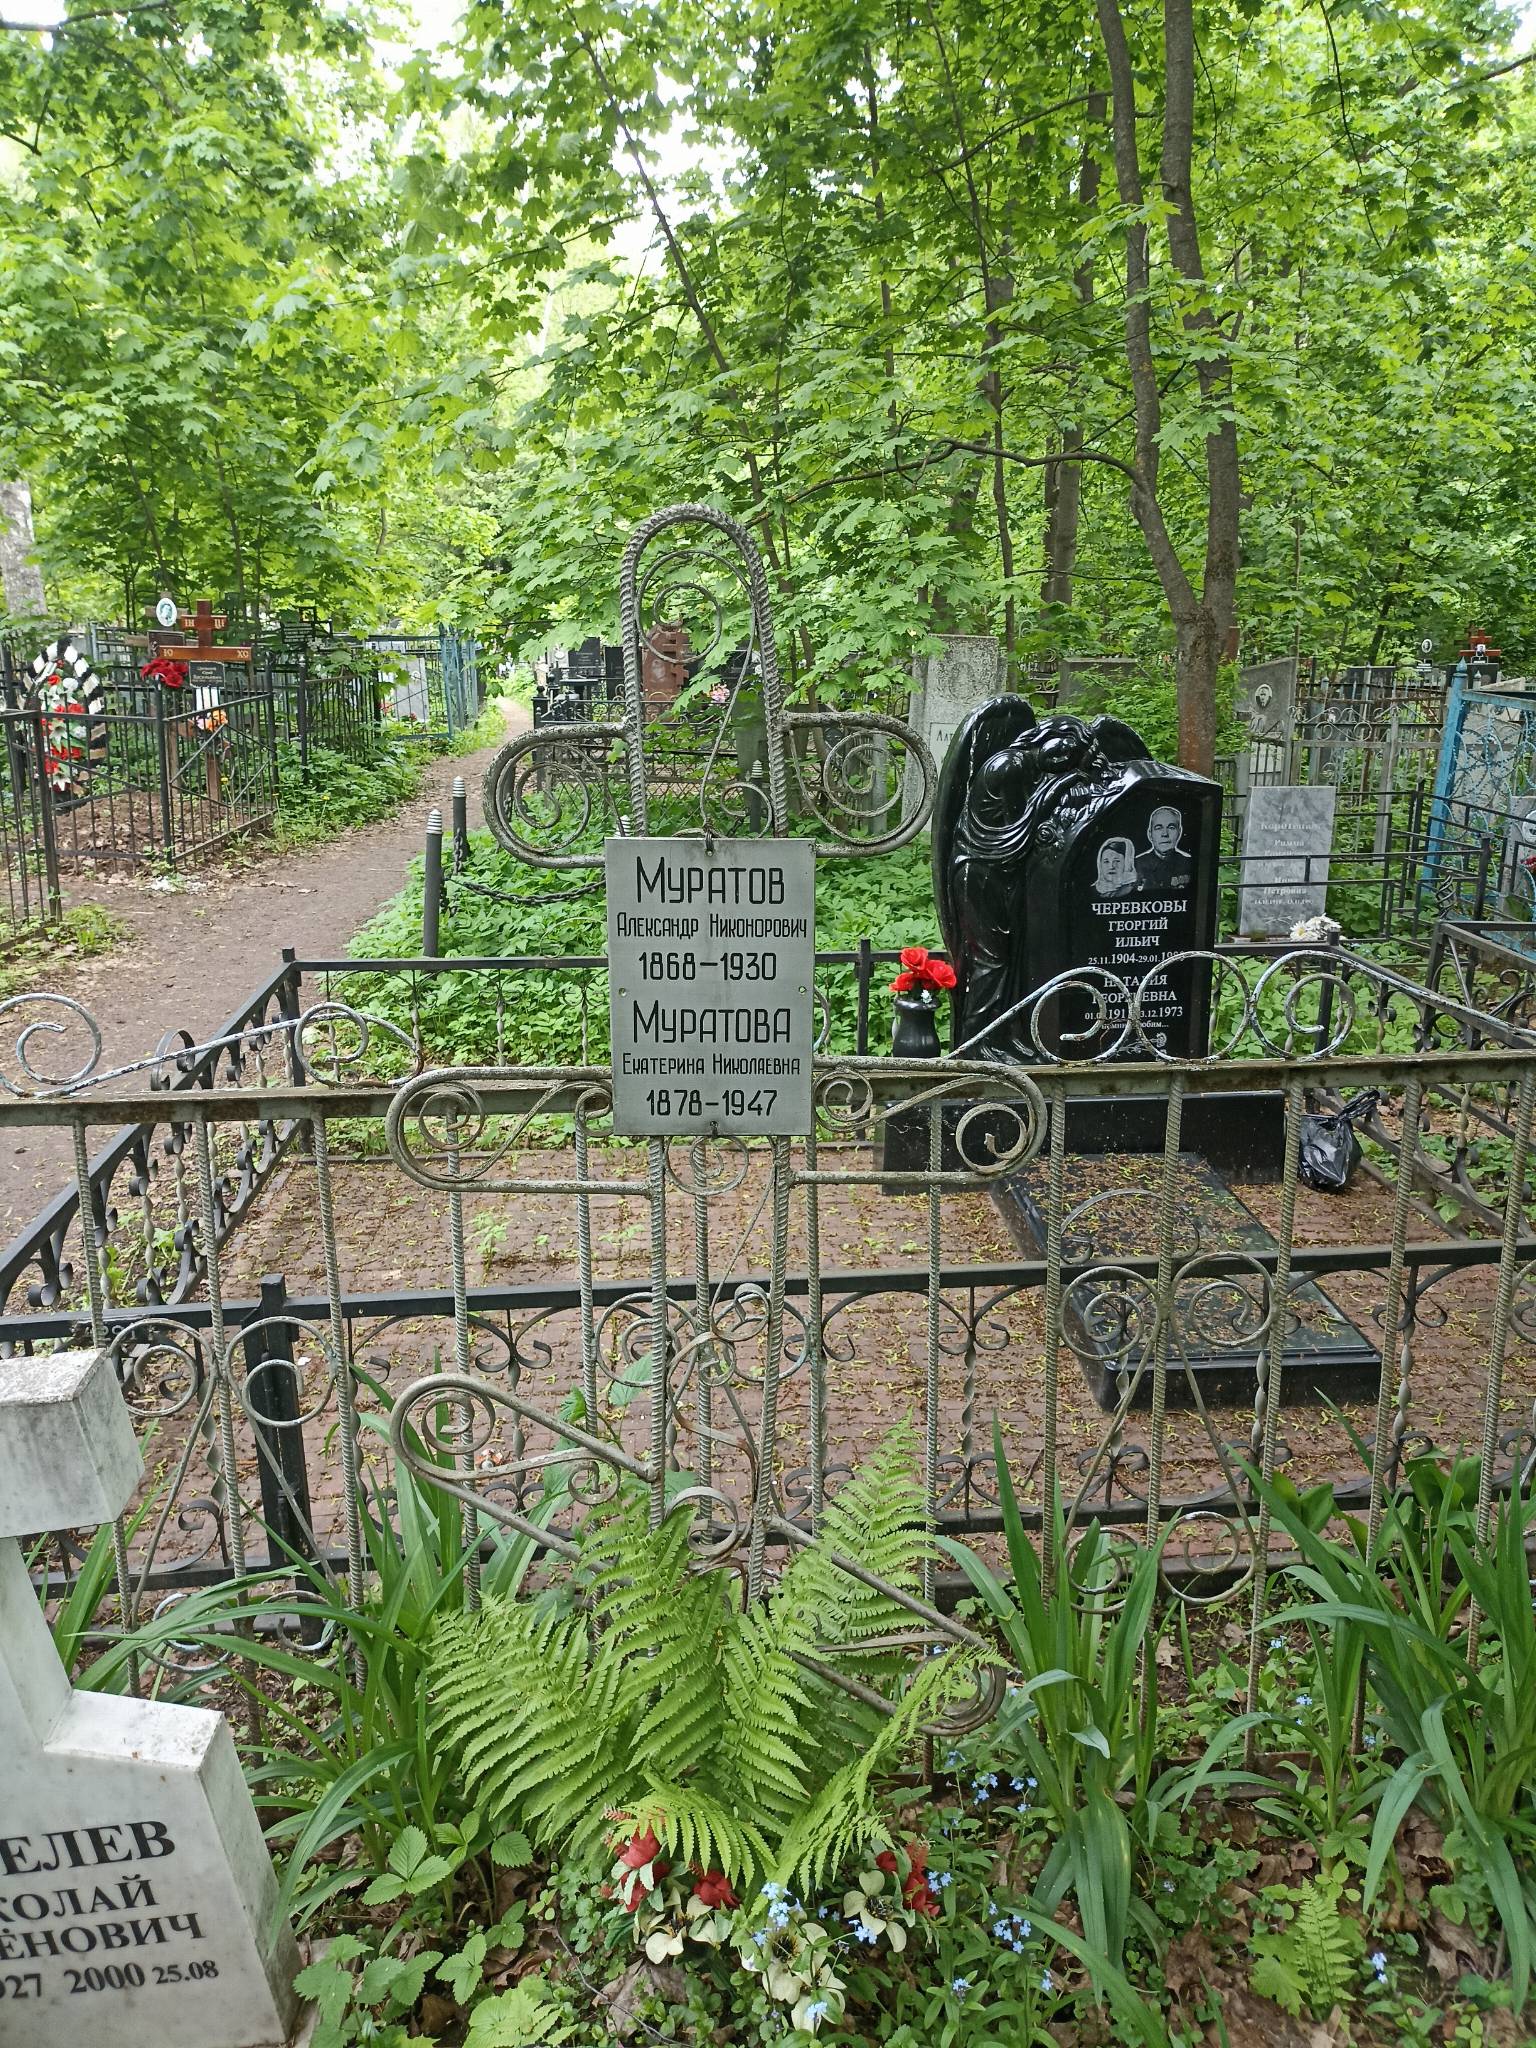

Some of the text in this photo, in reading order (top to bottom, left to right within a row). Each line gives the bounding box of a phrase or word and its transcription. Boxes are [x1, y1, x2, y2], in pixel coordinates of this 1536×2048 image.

[636, 856, 785, 905] МУРАТОВ
[1091, 900, 1188, 916] ЧЕРЕВКОВЫ
[617, 912, 807, 940] АЛЕКСАНДР НИКОНОРОВИЧ
[1108, 917, 1169, 932] ГЕОРГИЙ
[1115, 935, 1160, 948] ИЛЬИЧ
[638, 951, 777, 981] 1868-1930
[1103, 974, 1168, 988] НТАИЯ
[633, 1000, 791, 1044] МУРАТОВА
[622, 1052, 800, 1075] ЕКАТЕРИНА НИКОЛАЕВНА
[0, 1959, 220, 1999] 27 2000 25.08
